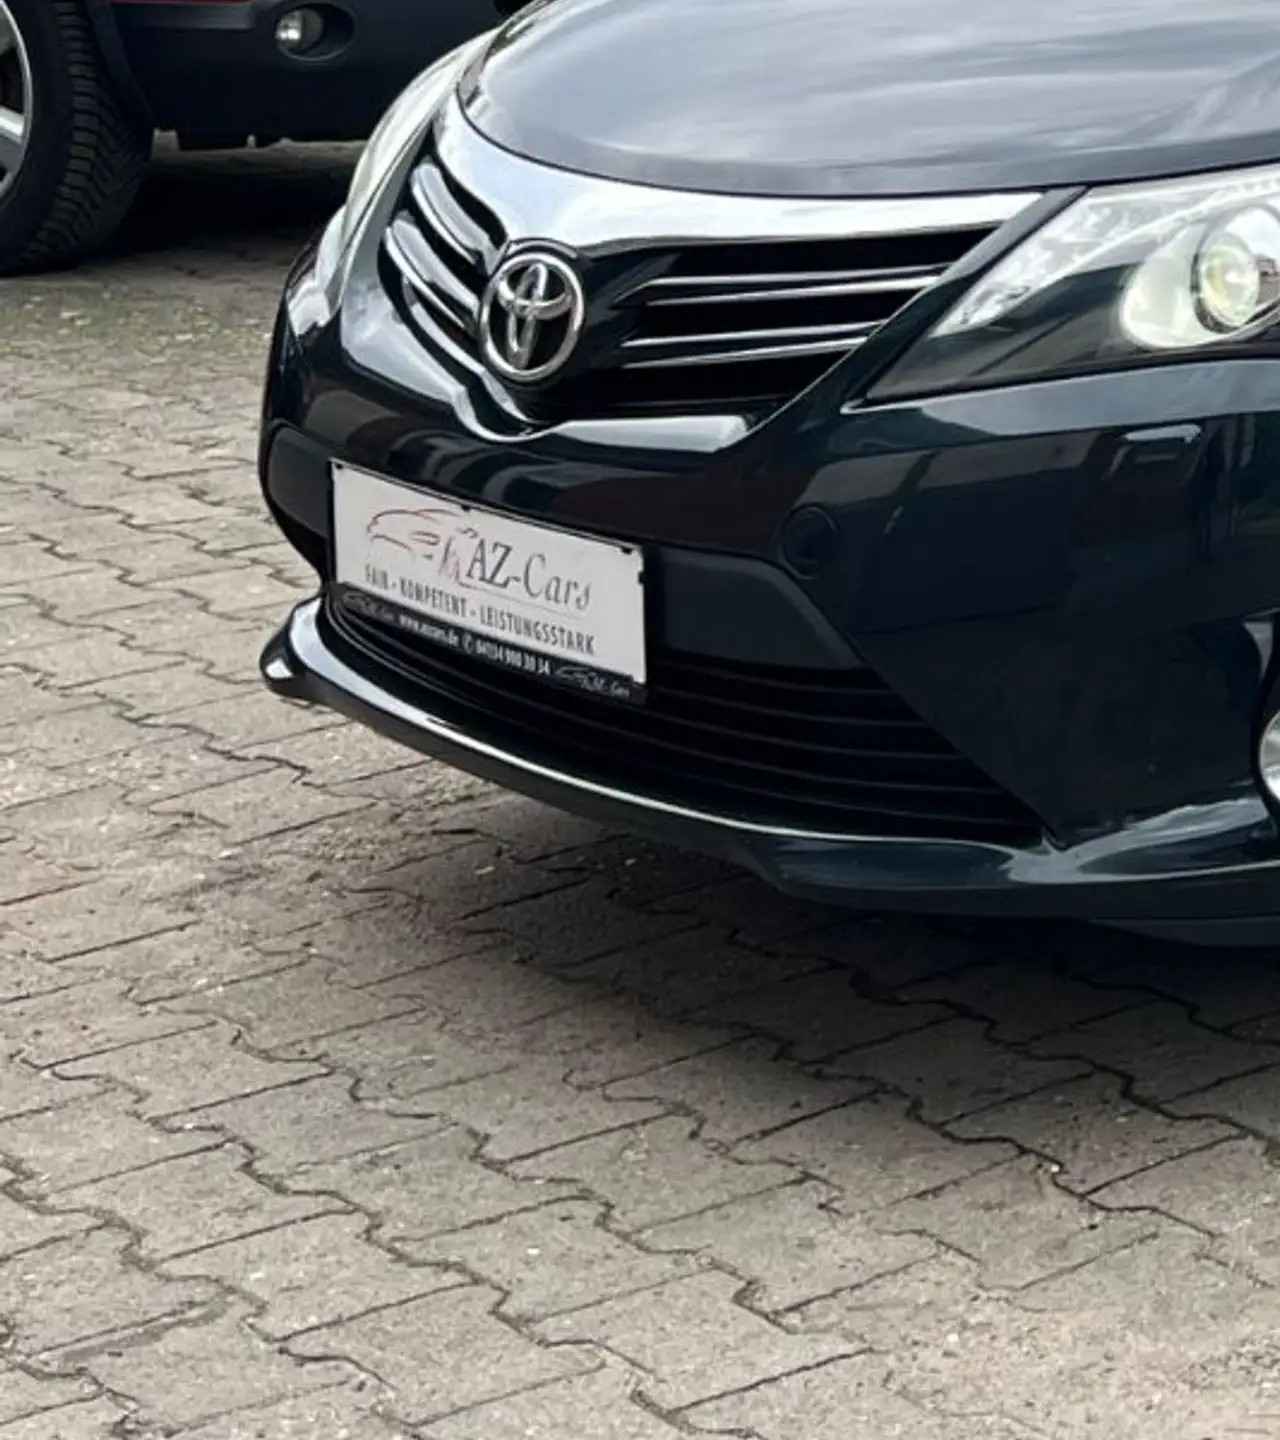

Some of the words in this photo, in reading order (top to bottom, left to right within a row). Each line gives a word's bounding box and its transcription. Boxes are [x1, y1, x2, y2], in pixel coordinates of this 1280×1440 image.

[465, 536, 592, 611] AZ-Cars
[399, 573, 468, 619] KOMPETENT
[479, 604, 596, 657] LEISTUNGSSTARK
